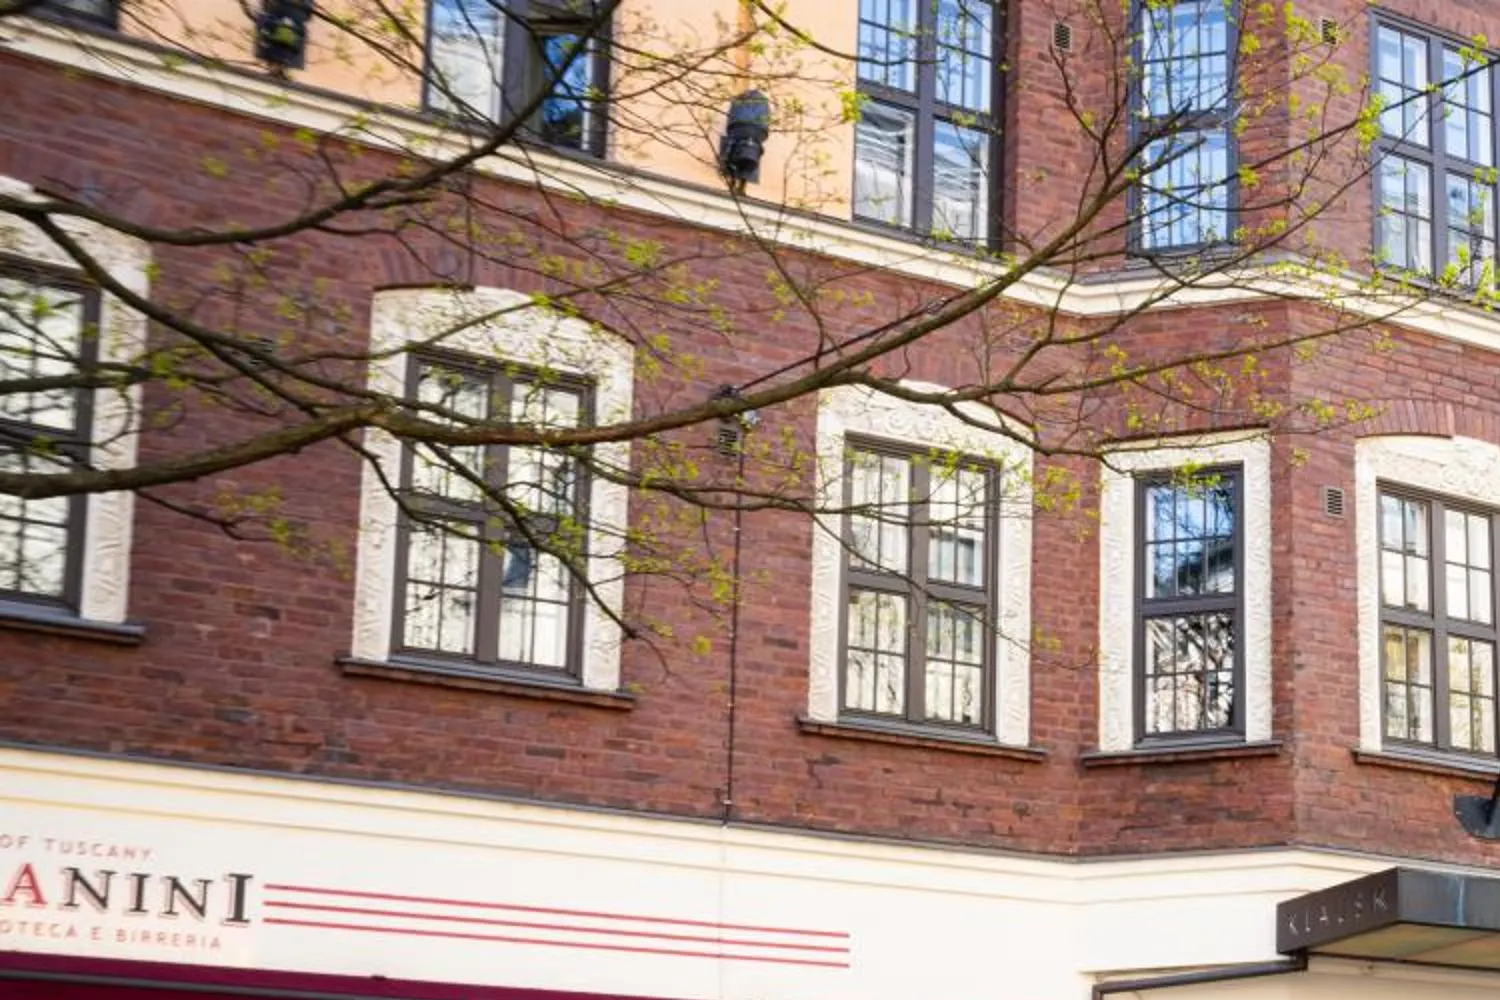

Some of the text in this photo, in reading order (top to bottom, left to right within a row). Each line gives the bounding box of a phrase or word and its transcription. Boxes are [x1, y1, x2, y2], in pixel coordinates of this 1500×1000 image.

[44, 838, 154, 861] TUSCANY
[0, 862, 254, 928] ANINI
[90, 925, 103, 941] E
